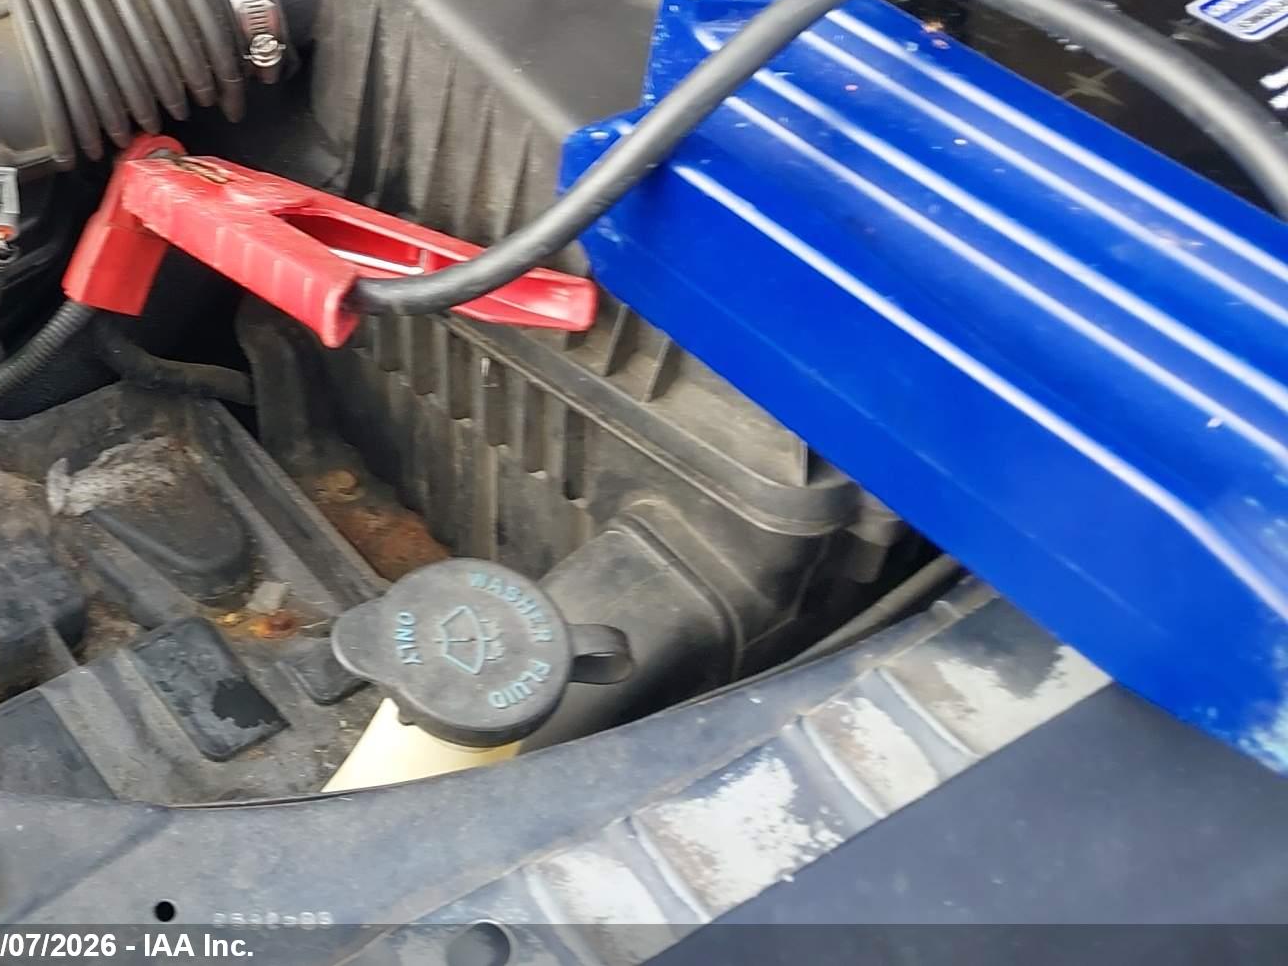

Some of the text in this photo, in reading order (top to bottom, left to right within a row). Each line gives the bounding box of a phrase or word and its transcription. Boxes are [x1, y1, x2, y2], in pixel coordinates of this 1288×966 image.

[392, 571, 554, 710] WASHER FLUID ONLY
